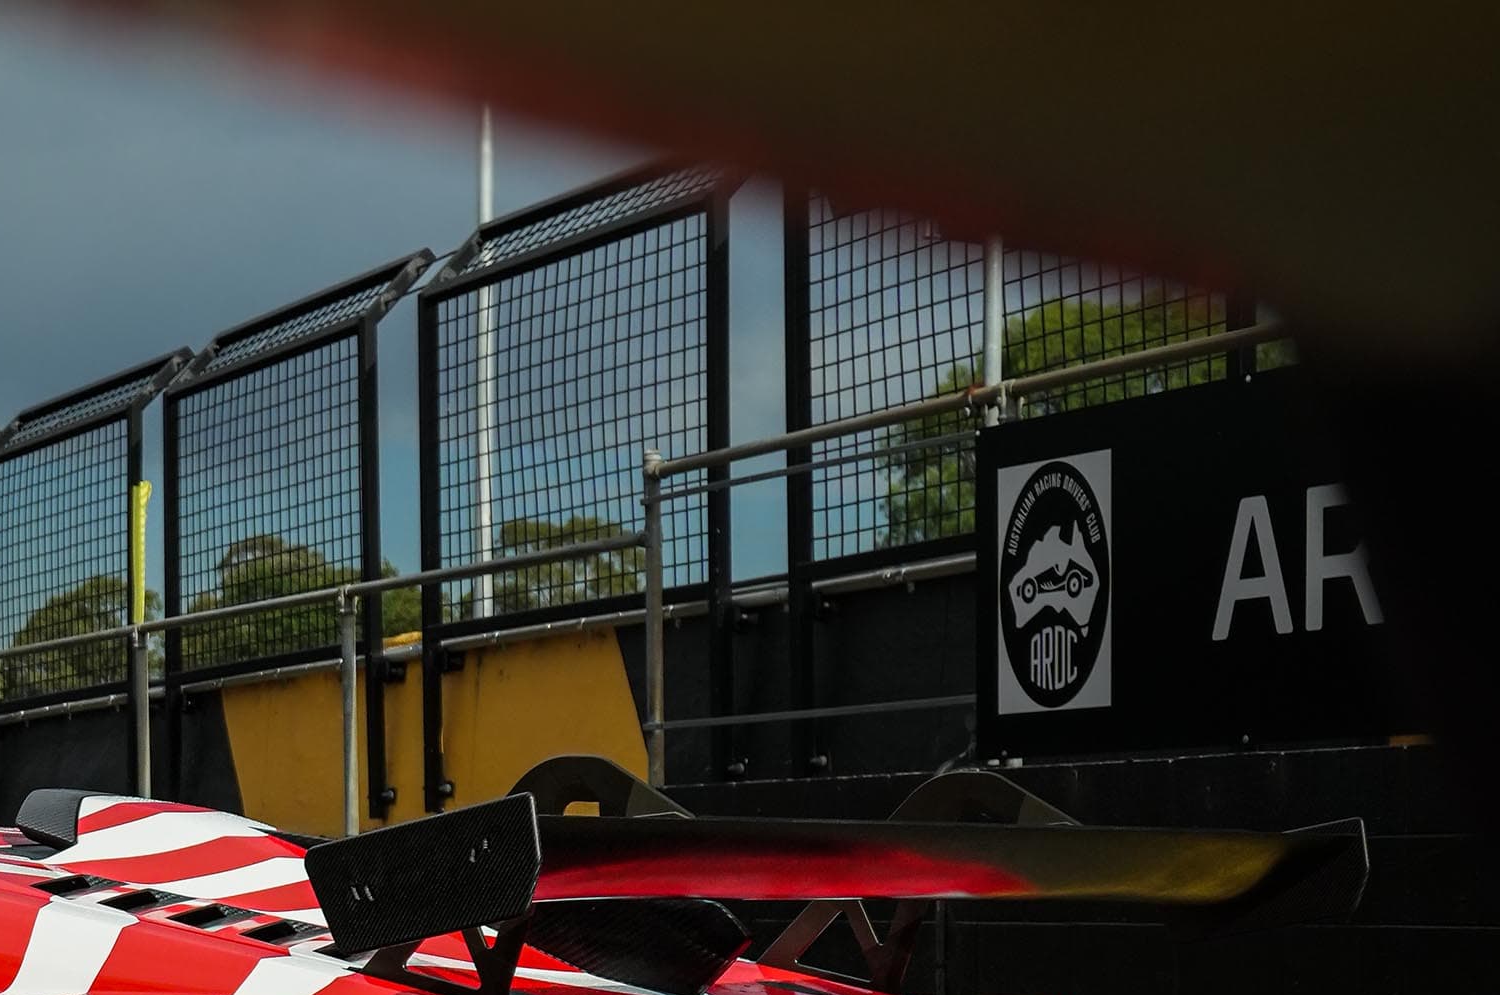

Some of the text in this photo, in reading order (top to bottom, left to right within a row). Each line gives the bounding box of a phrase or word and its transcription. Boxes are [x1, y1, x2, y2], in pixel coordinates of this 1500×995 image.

[1008, 491, 1036, 556] AUSTRALIAN
[1034, 473, 1062, 497] RACING
[1086, 513, 1101, 544] CLUB
[1030, 625, 1078, 690] ARDC
